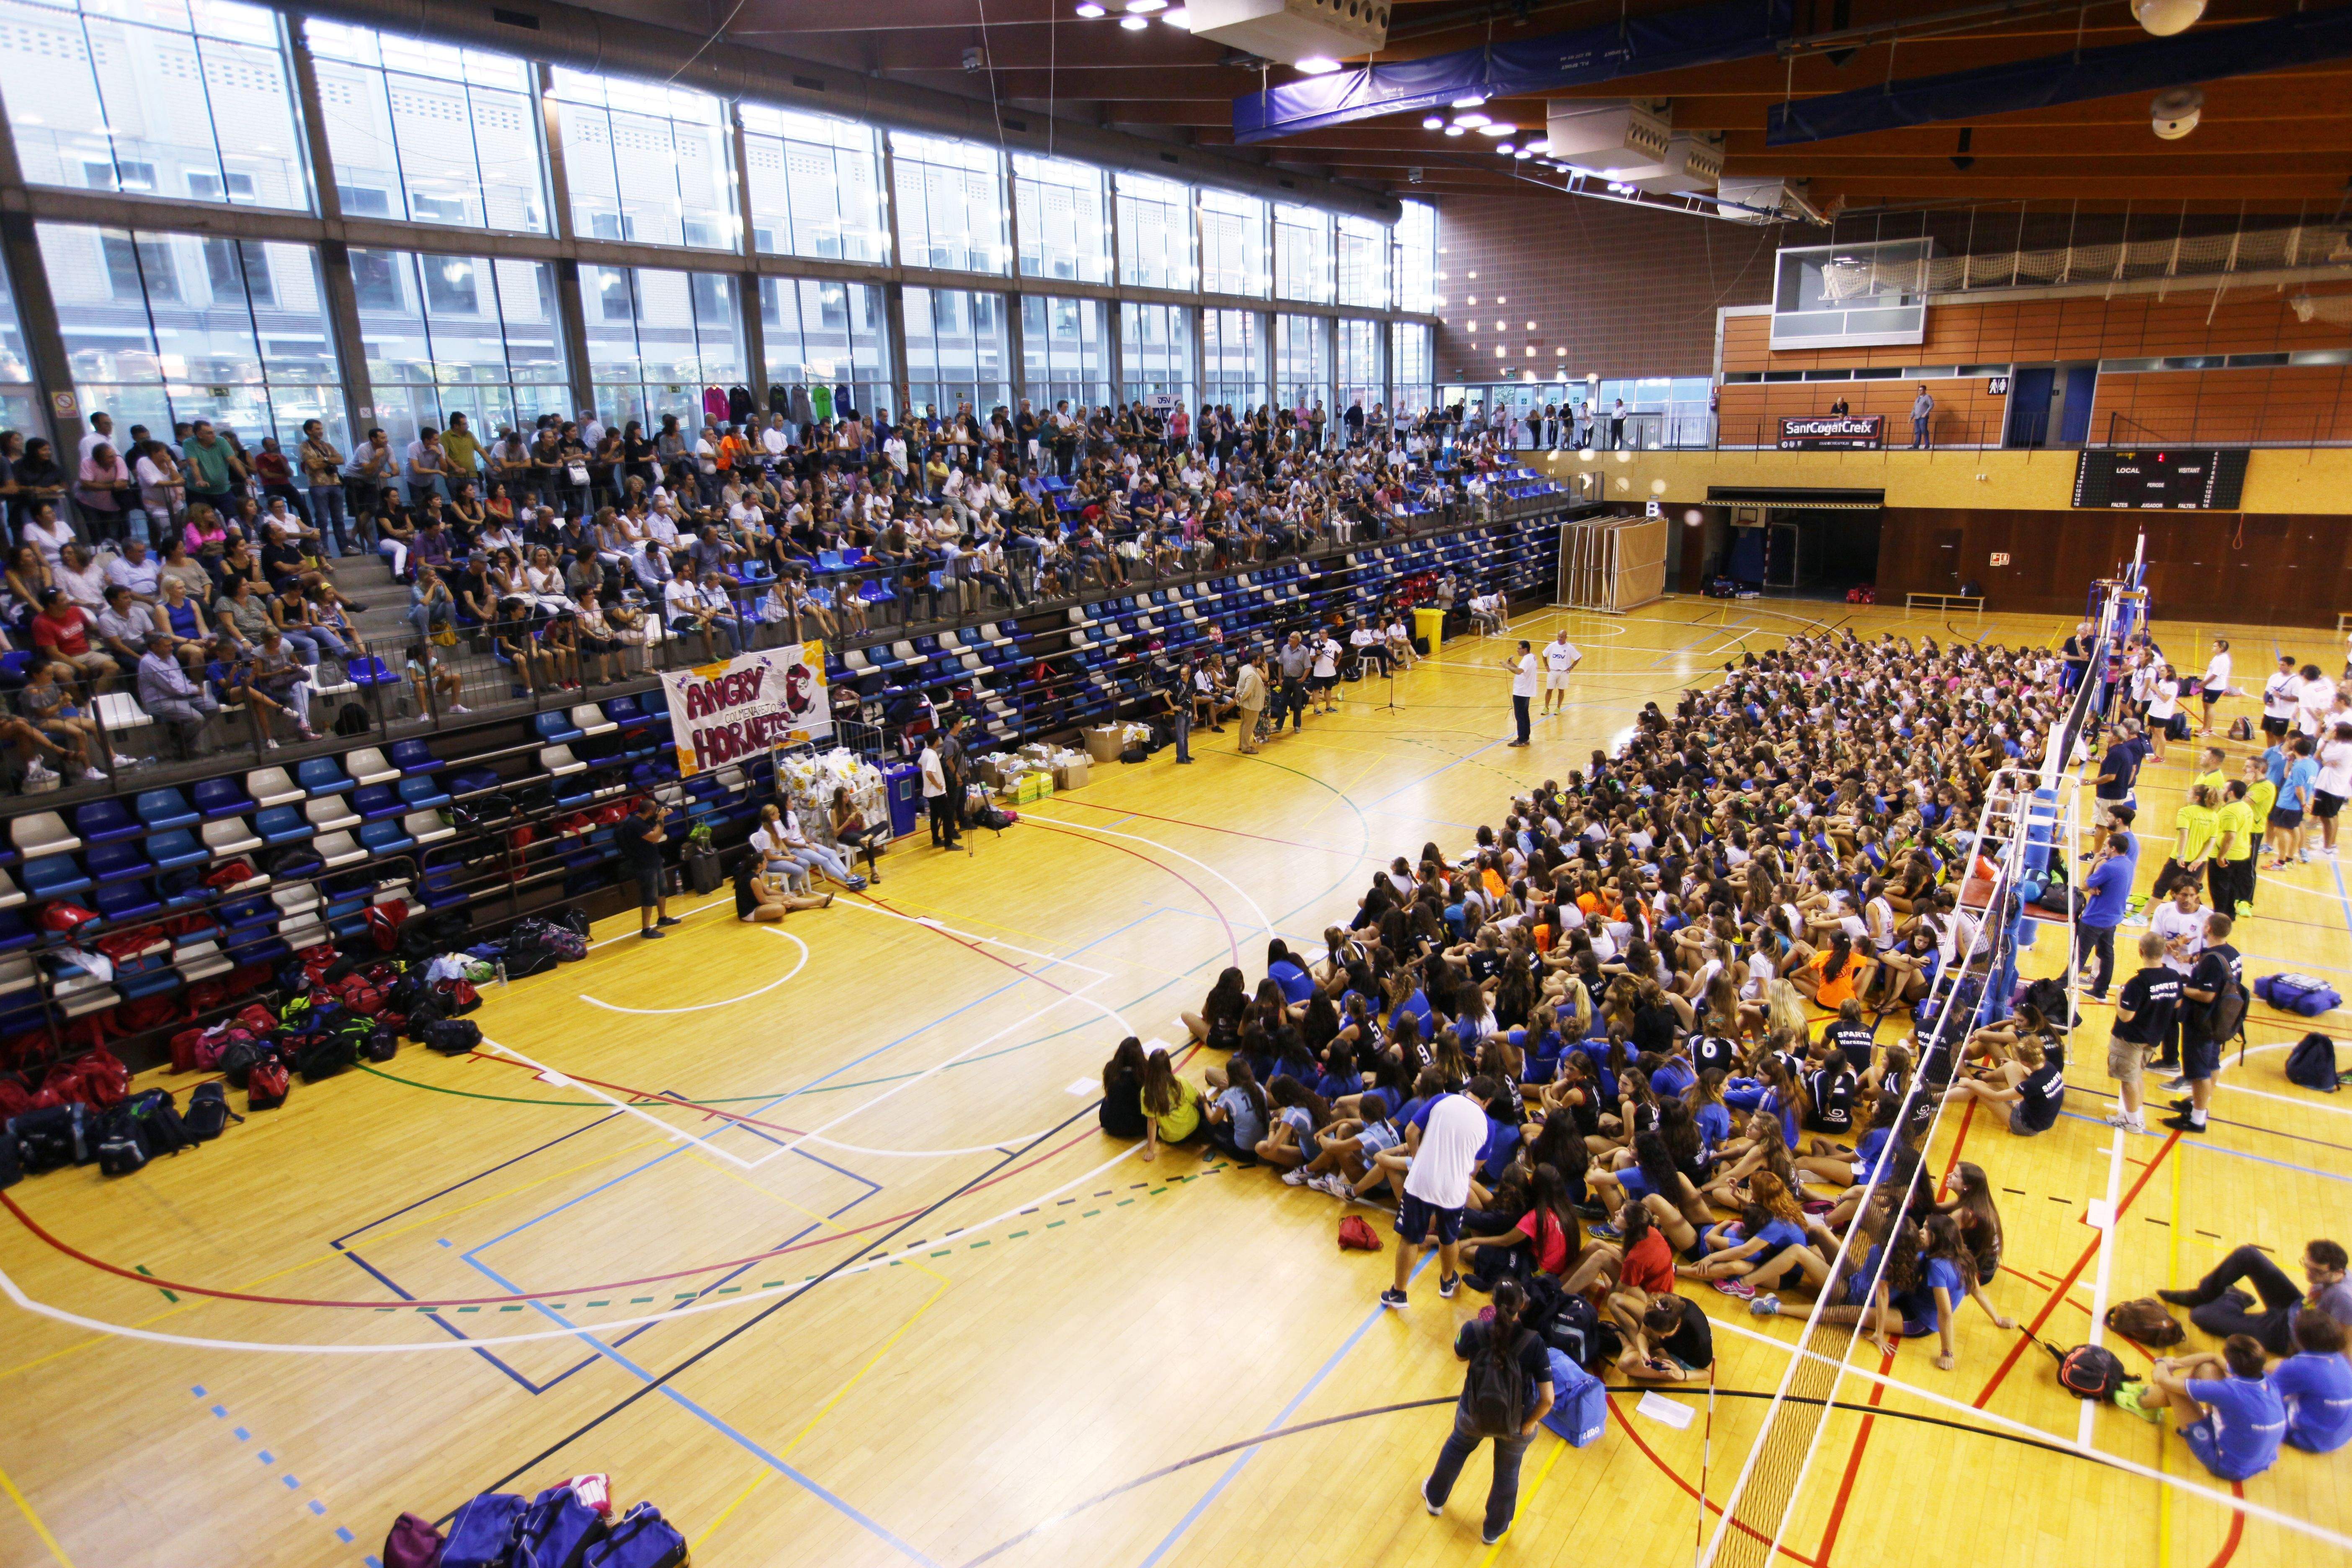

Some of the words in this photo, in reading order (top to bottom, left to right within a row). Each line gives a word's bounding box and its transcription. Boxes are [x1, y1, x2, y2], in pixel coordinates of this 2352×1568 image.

[1786, 421, 1872, 436] SantCugatCreix
[1646, 502, 1659, 517] B
[687, 666, 765, 720] ANGRY
[725, 704, 776, 724] COLMENAREJO
[692, 711, 791, 770] HORNETS
[1368, 1020, 1381, 1040] 5
[1417, 1044, 1431, 1064] 9
[1702, 1037, 1716, 1058] 6
[1505, 1074, 1518, 1095] 8
